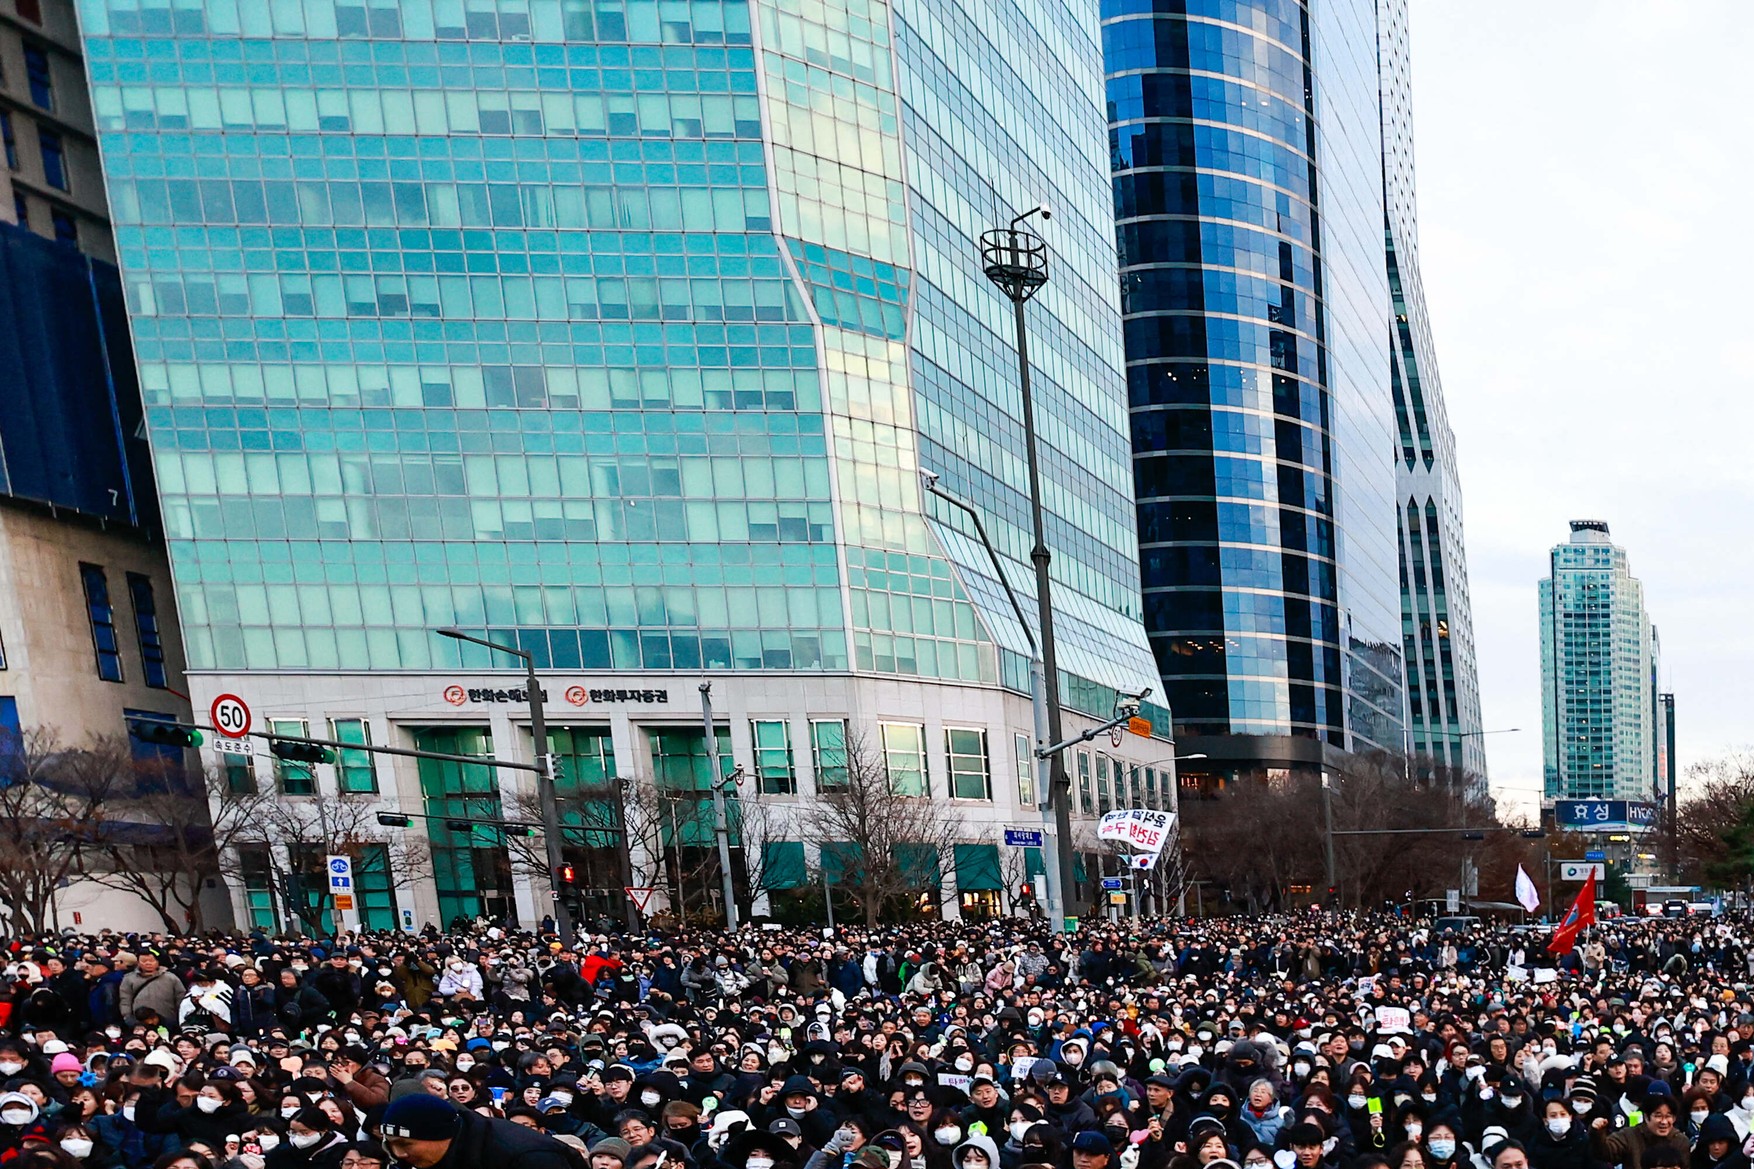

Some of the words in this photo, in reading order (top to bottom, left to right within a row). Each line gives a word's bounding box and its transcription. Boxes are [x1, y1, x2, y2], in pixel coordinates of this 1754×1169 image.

[589, 689, 668, 703] 한화투자증권
[220, 705, 243, 728] 50
[214, 741, 251, 754] 속도준수
[1574, 803, 1609, 821] 효성
